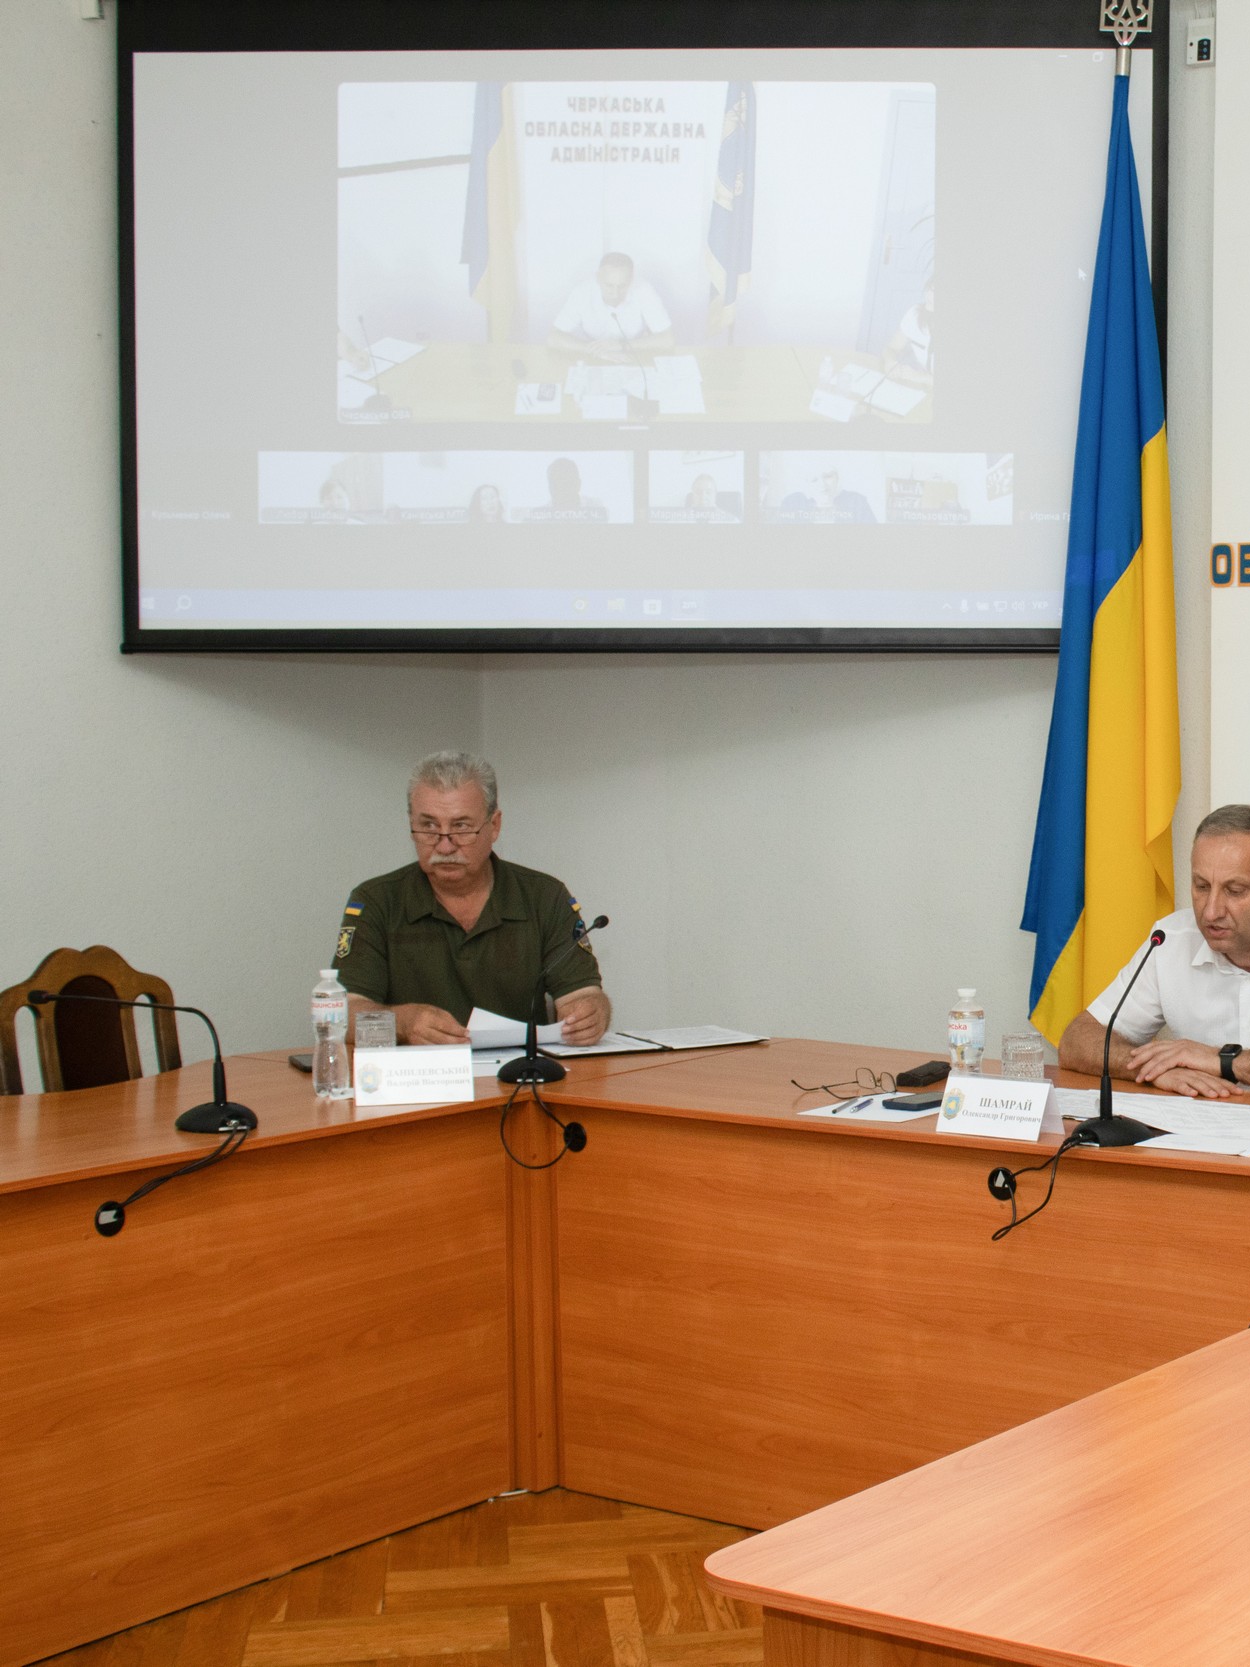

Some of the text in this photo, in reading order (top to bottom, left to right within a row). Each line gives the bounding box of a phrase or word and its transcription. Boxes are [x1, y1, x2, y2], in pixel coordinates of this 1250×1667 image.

[567, 96, 666, 113] ЧЕРКАСЬКА
[524, 121, 706, 138] ОБЛАСНА ДЕРЖАВНА
[385, 1065, 470, 1078] ДАНИЛЕВСЬКИЙ
[386, 1078, 420, 1088] Валерій
[979, 1097, 1033, 1112] ШАМРАЙ
[961, 1110, 1042, 1124] Олександр Григорович
